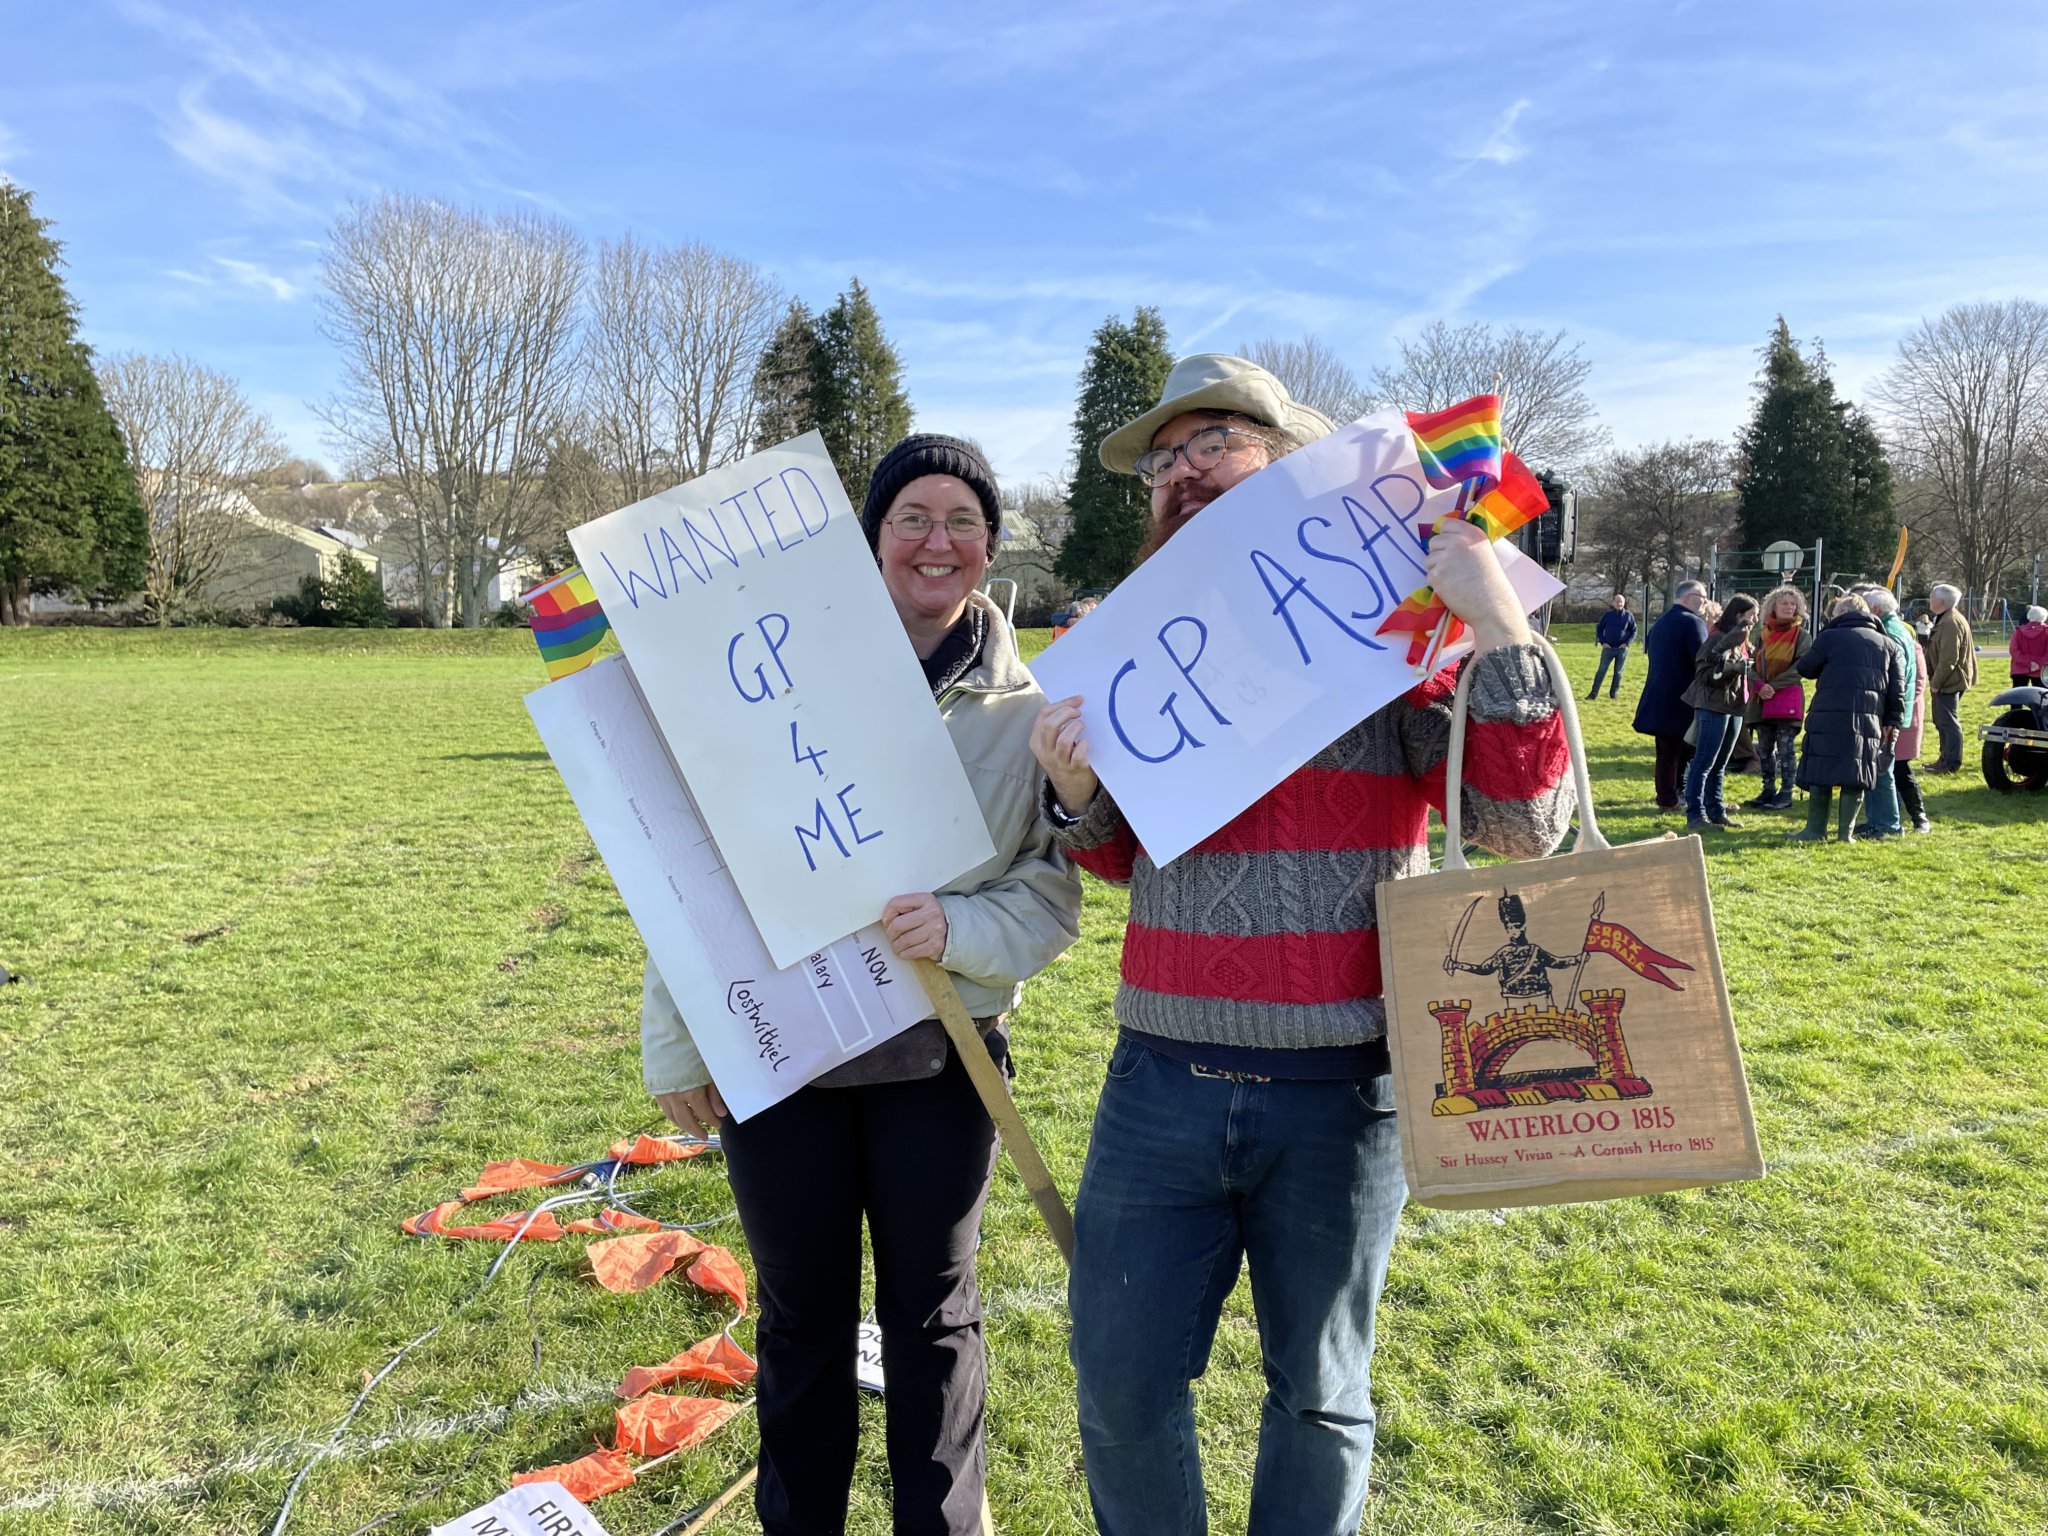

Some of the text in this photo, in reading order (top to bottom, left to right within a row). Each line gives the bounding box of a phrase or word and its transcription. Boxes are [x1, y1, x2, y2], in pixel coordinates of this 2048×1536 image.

[600, 467, 829, 609] WANTED
[1107, 472, 1428, 764] GP ASAP
[727, 612, 794, 704] GP
[791, 721, 828, 776] 4
[794, 783, 884, 873] ME
[810, 953, 834, 989] alary
[860, 946, 893, 986] NOW
[1465, 1105, 1676, 1143] WATERLOO 1815
[1464, 1152, 1509, 1168] Hussey
[1514, 1149, 1554, 1163] Vivian
[1573, 1145, 1586, 1158] A
[1591, 1141, 1643, 1157] Cornish
[1650, 1138, 1683, 1154] Hero
